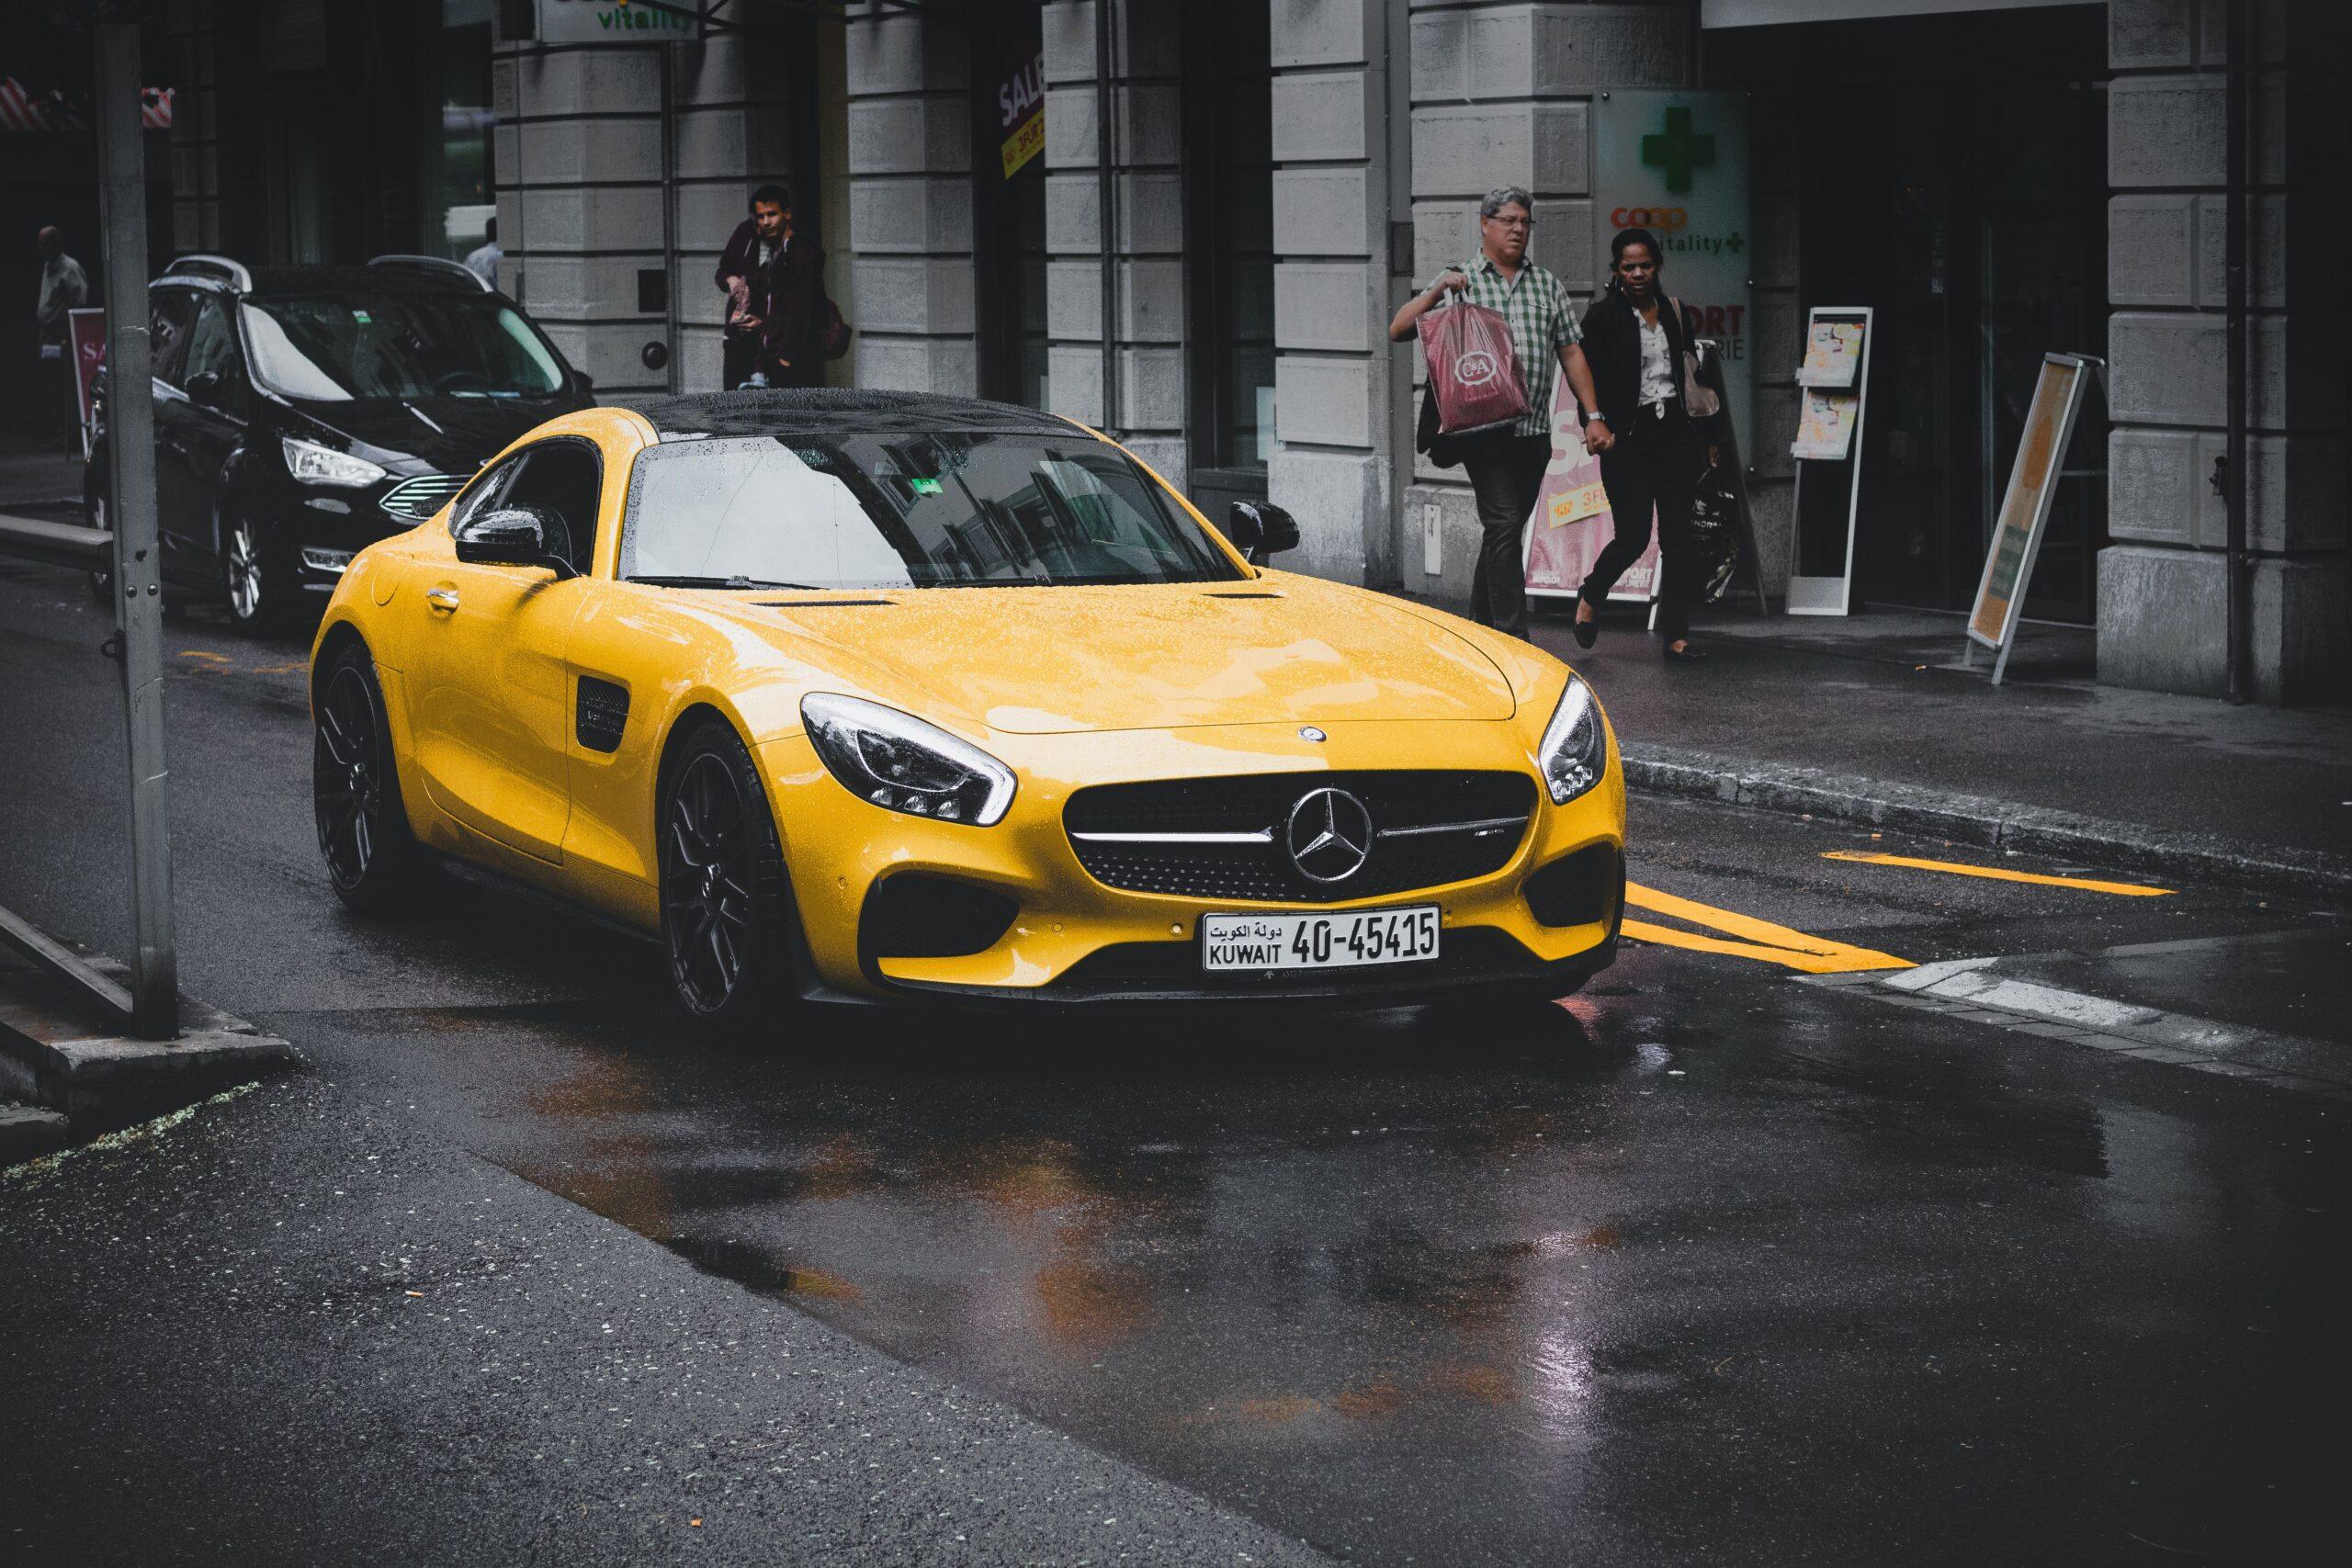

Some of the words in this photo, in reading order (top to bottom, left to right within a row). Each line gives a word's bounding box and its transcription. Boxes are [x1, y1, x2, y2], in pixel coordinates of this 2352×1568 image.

[1611, 207, 1688, 235] coop
[1658, 235, 1722, 255] itality
[1687, 305, 1745, 336] ORT
[1210, 924, 1250, 942] الكويت
[1254, 921, 1283, 941] دولة
[1292, 912, 1434, 963] 40-45415
[1210, 944, 1282, 964] KUWAIT
